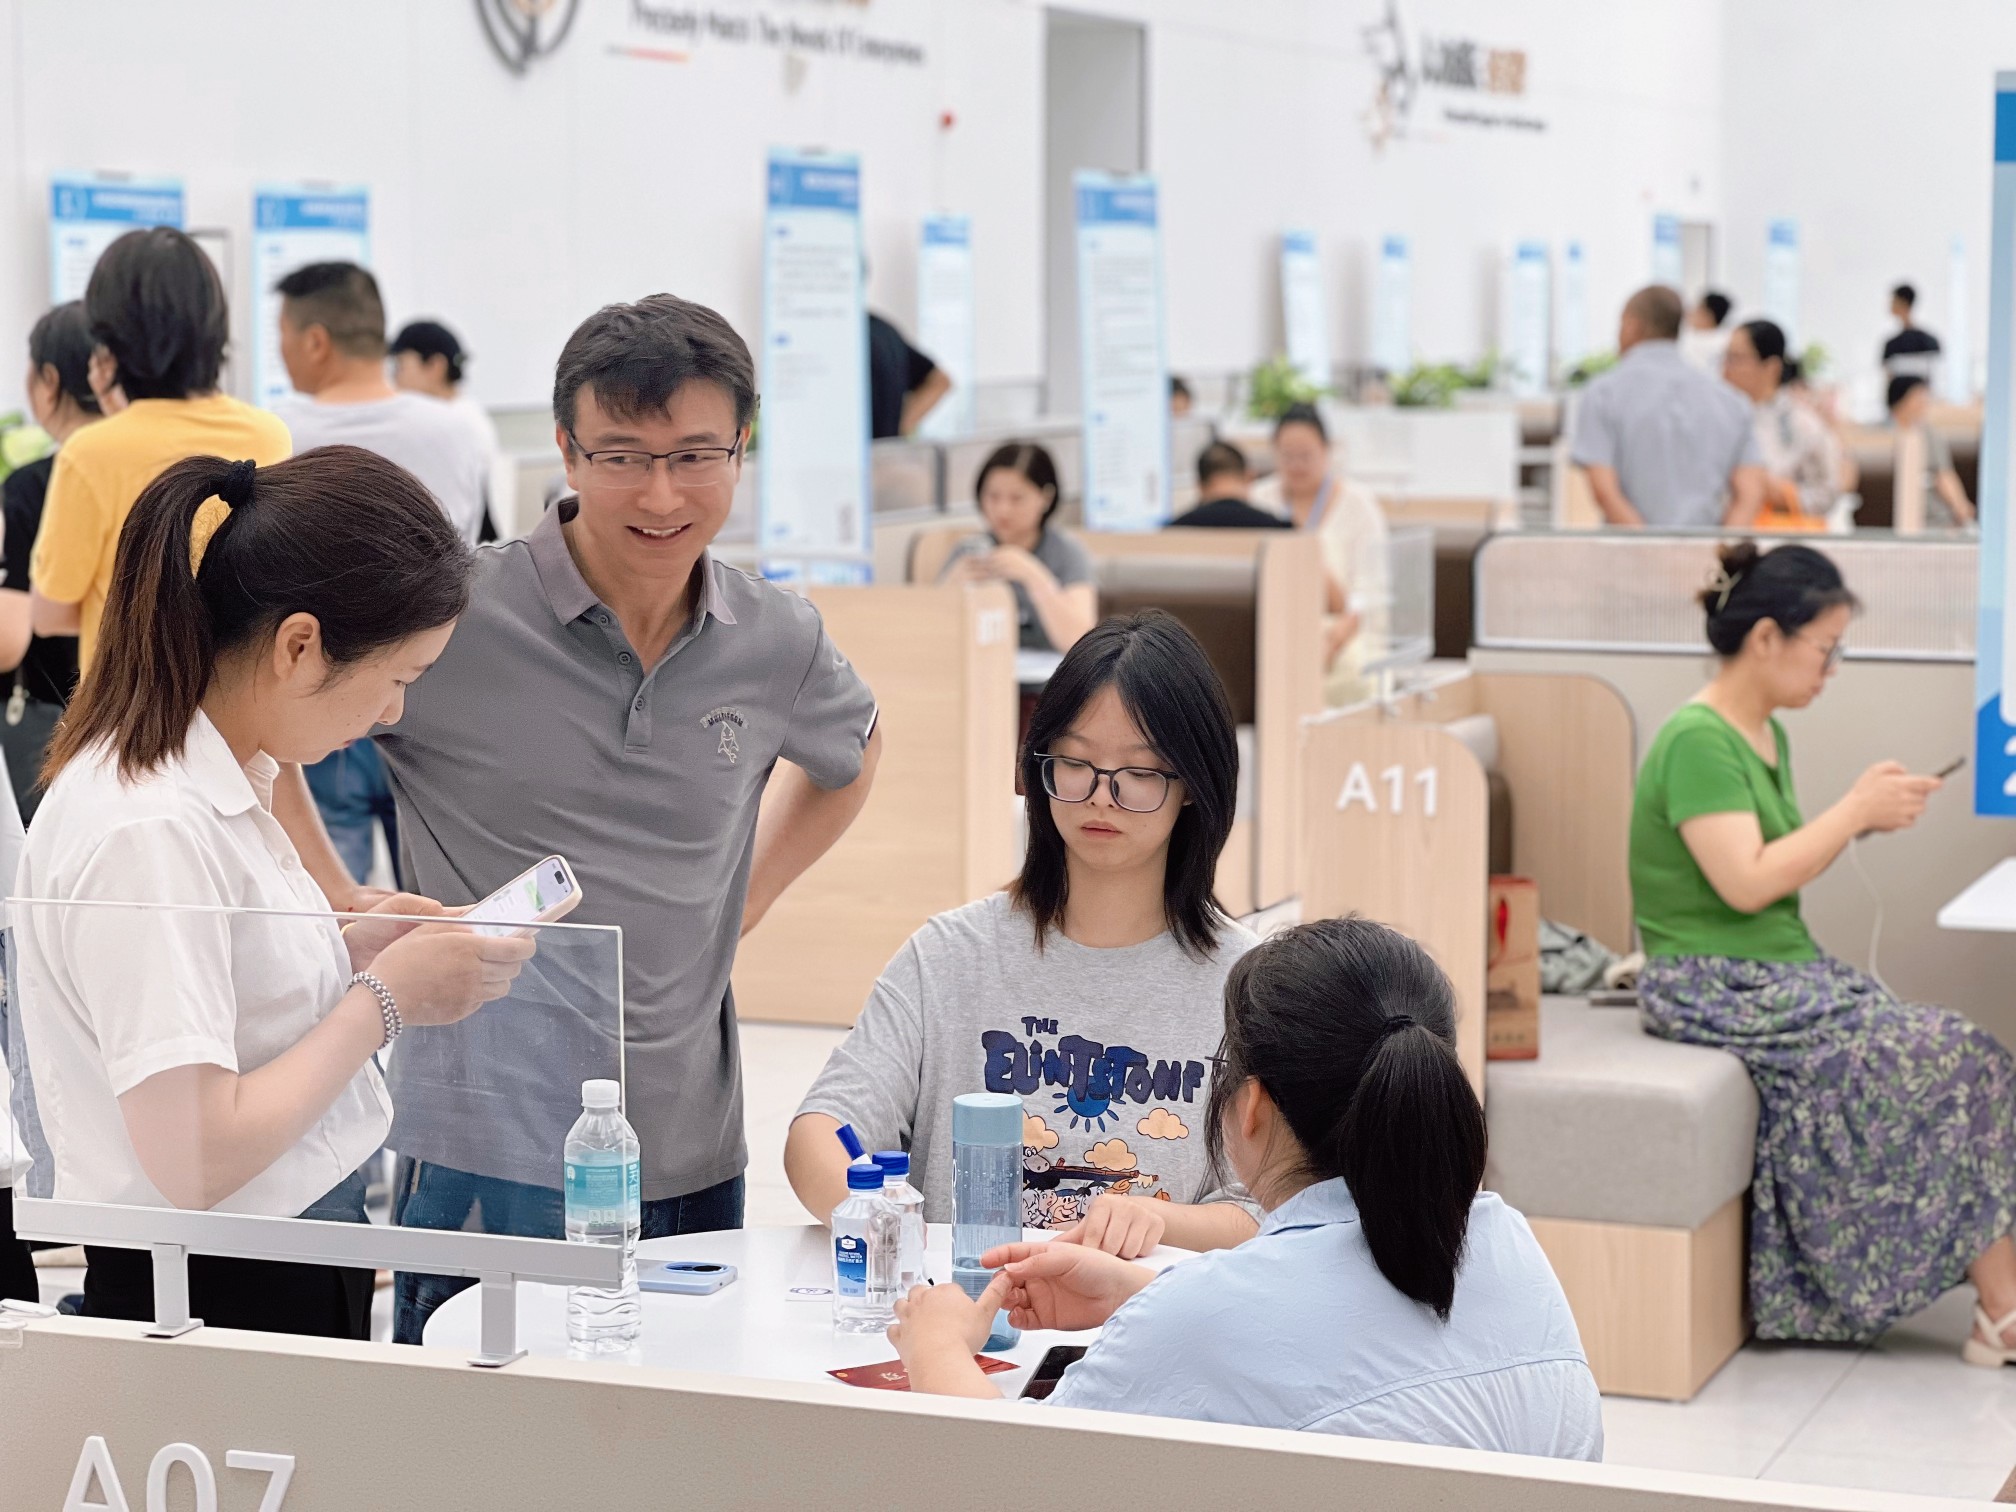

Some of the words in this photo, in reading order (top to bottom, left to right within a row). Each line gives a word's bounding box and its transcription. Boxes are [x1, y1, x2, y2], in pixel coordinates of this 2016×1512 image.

[1336, 762, 1437, 817] A11
[1021, 1016, 1058, 1037] THE
[62, 1435, 296, 1512] A07
